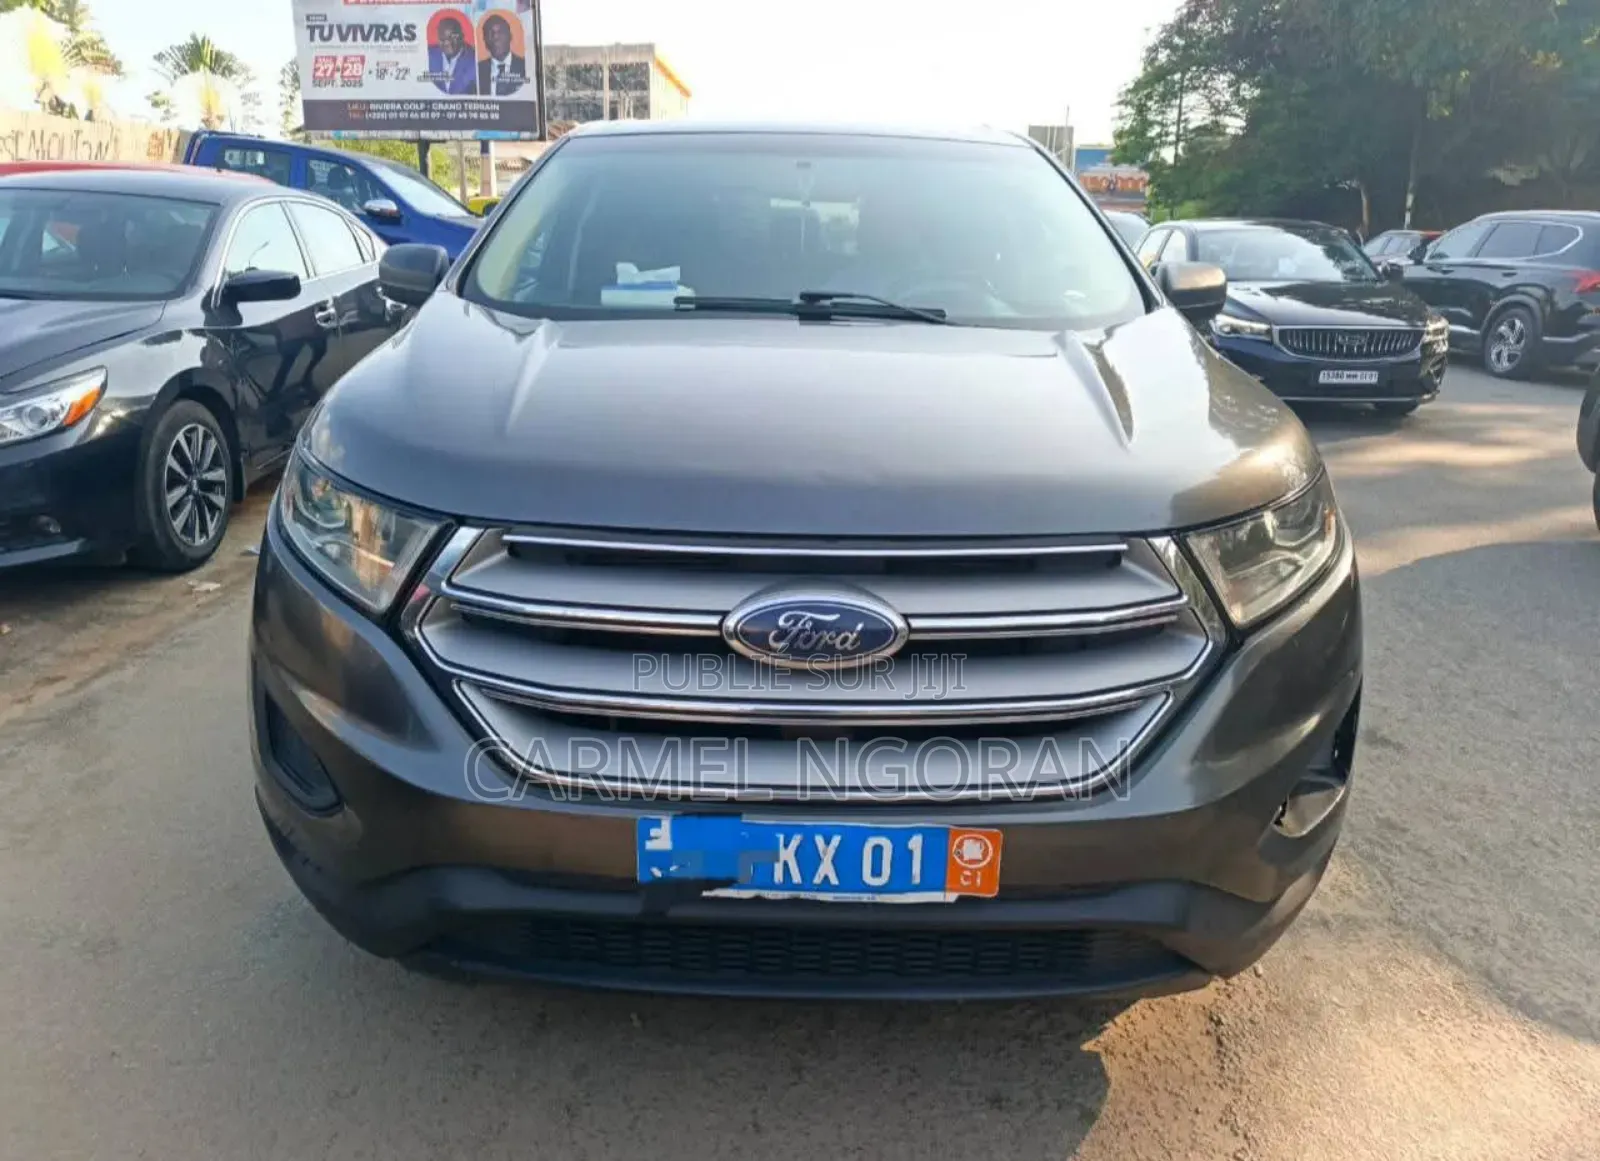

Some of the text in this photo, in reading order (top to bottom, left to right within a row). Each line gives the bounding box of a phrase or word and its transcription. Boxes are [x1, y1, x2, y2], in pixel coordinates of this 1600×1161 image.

[306, 24, 417, 42] TU VIVRAS
[315, 63, 335, 77] 27
[343, 62, 362, 77] 28
[403, 103, 426, 111] GOLF
[432, 103, 462, 111] GRAND
[463, 103, 500, 111] TERRAIN
[769, 611, 865, 652] Ford
[861, 833, 924, 886] 01
[960, 869, 981, 888] CI
